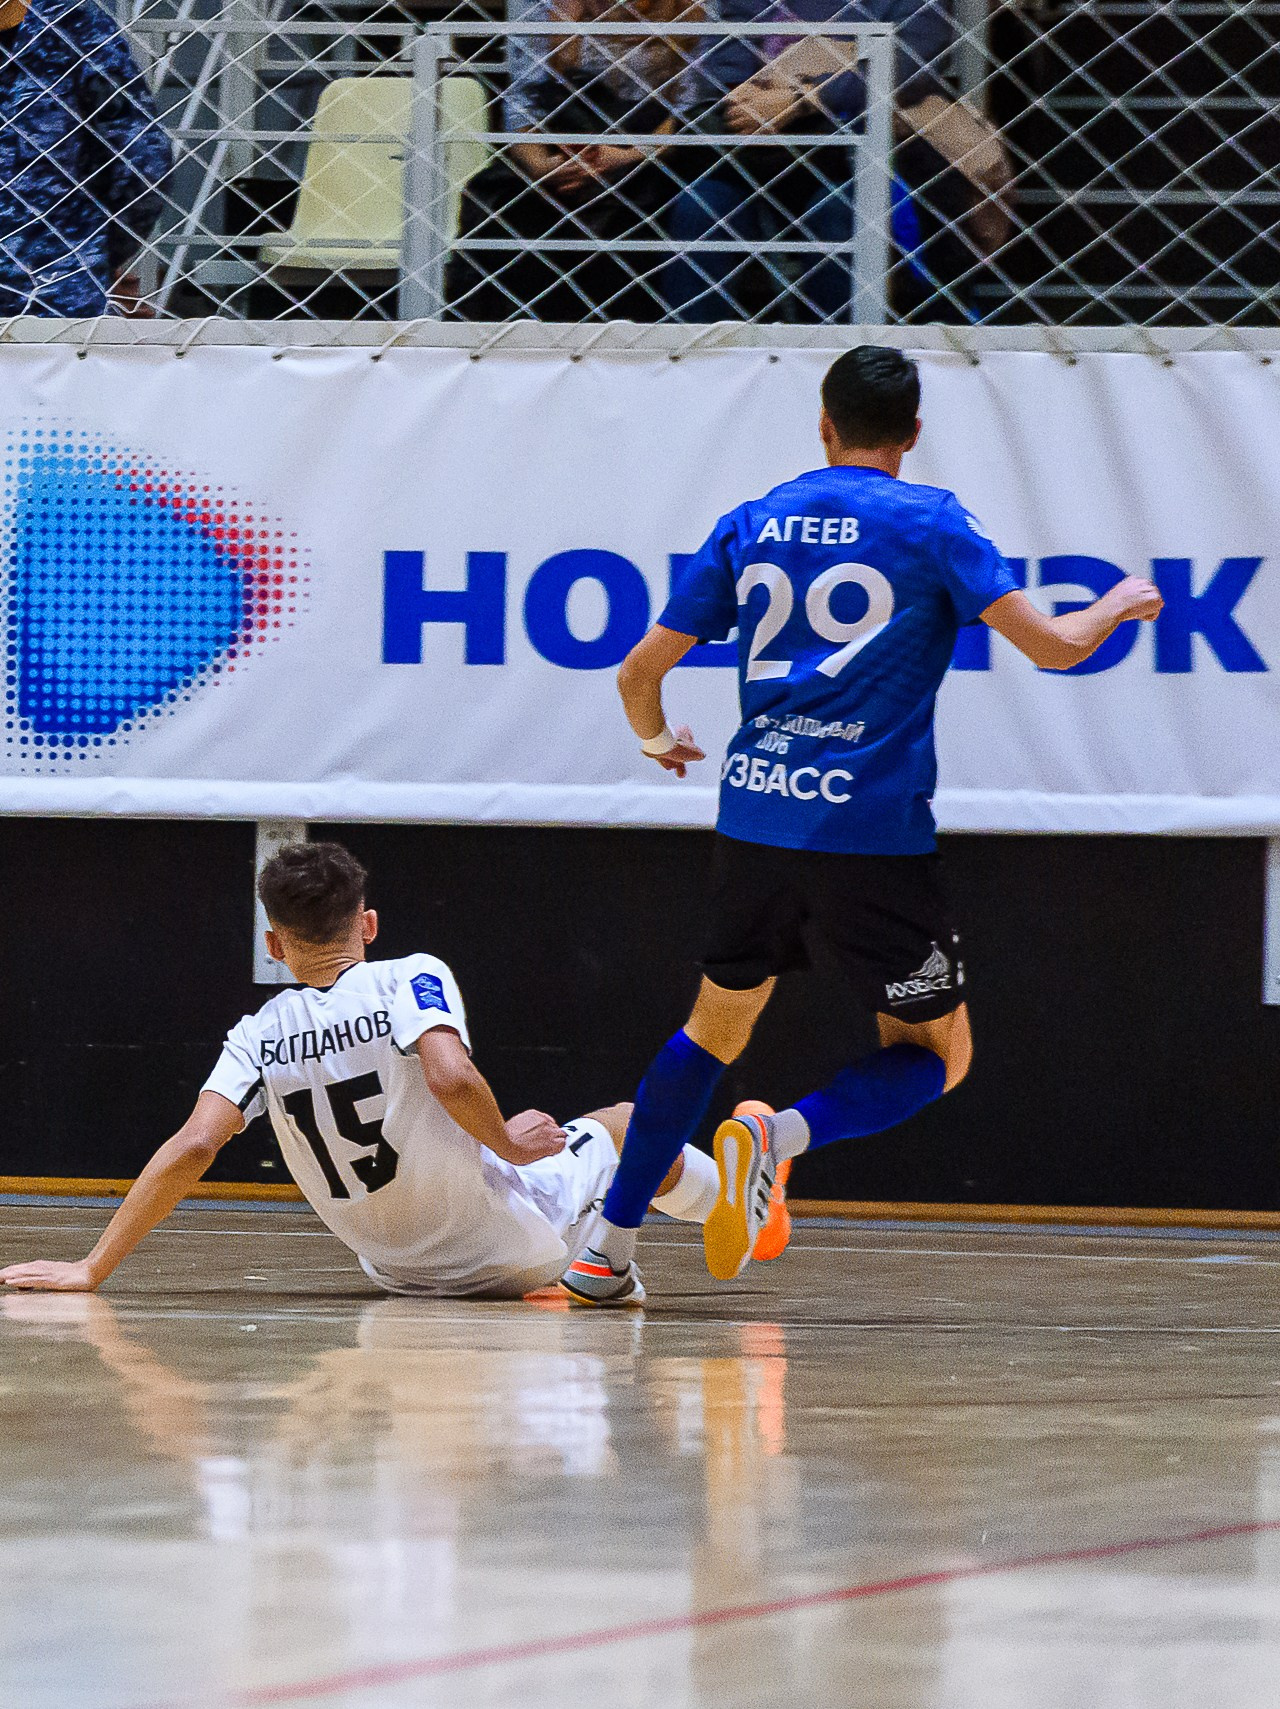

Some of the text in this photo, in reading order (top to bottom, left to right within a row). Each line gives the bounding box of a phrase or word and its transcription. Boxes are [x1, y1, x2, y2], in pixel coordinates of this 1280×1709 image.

[757, 515, 859, 544] АГЕЕВ
[735, 562, 895, 683] 29
[260, 1010, 392, 1066] БОГДАНОВ
[282, 1070, 399, 1200] 15
